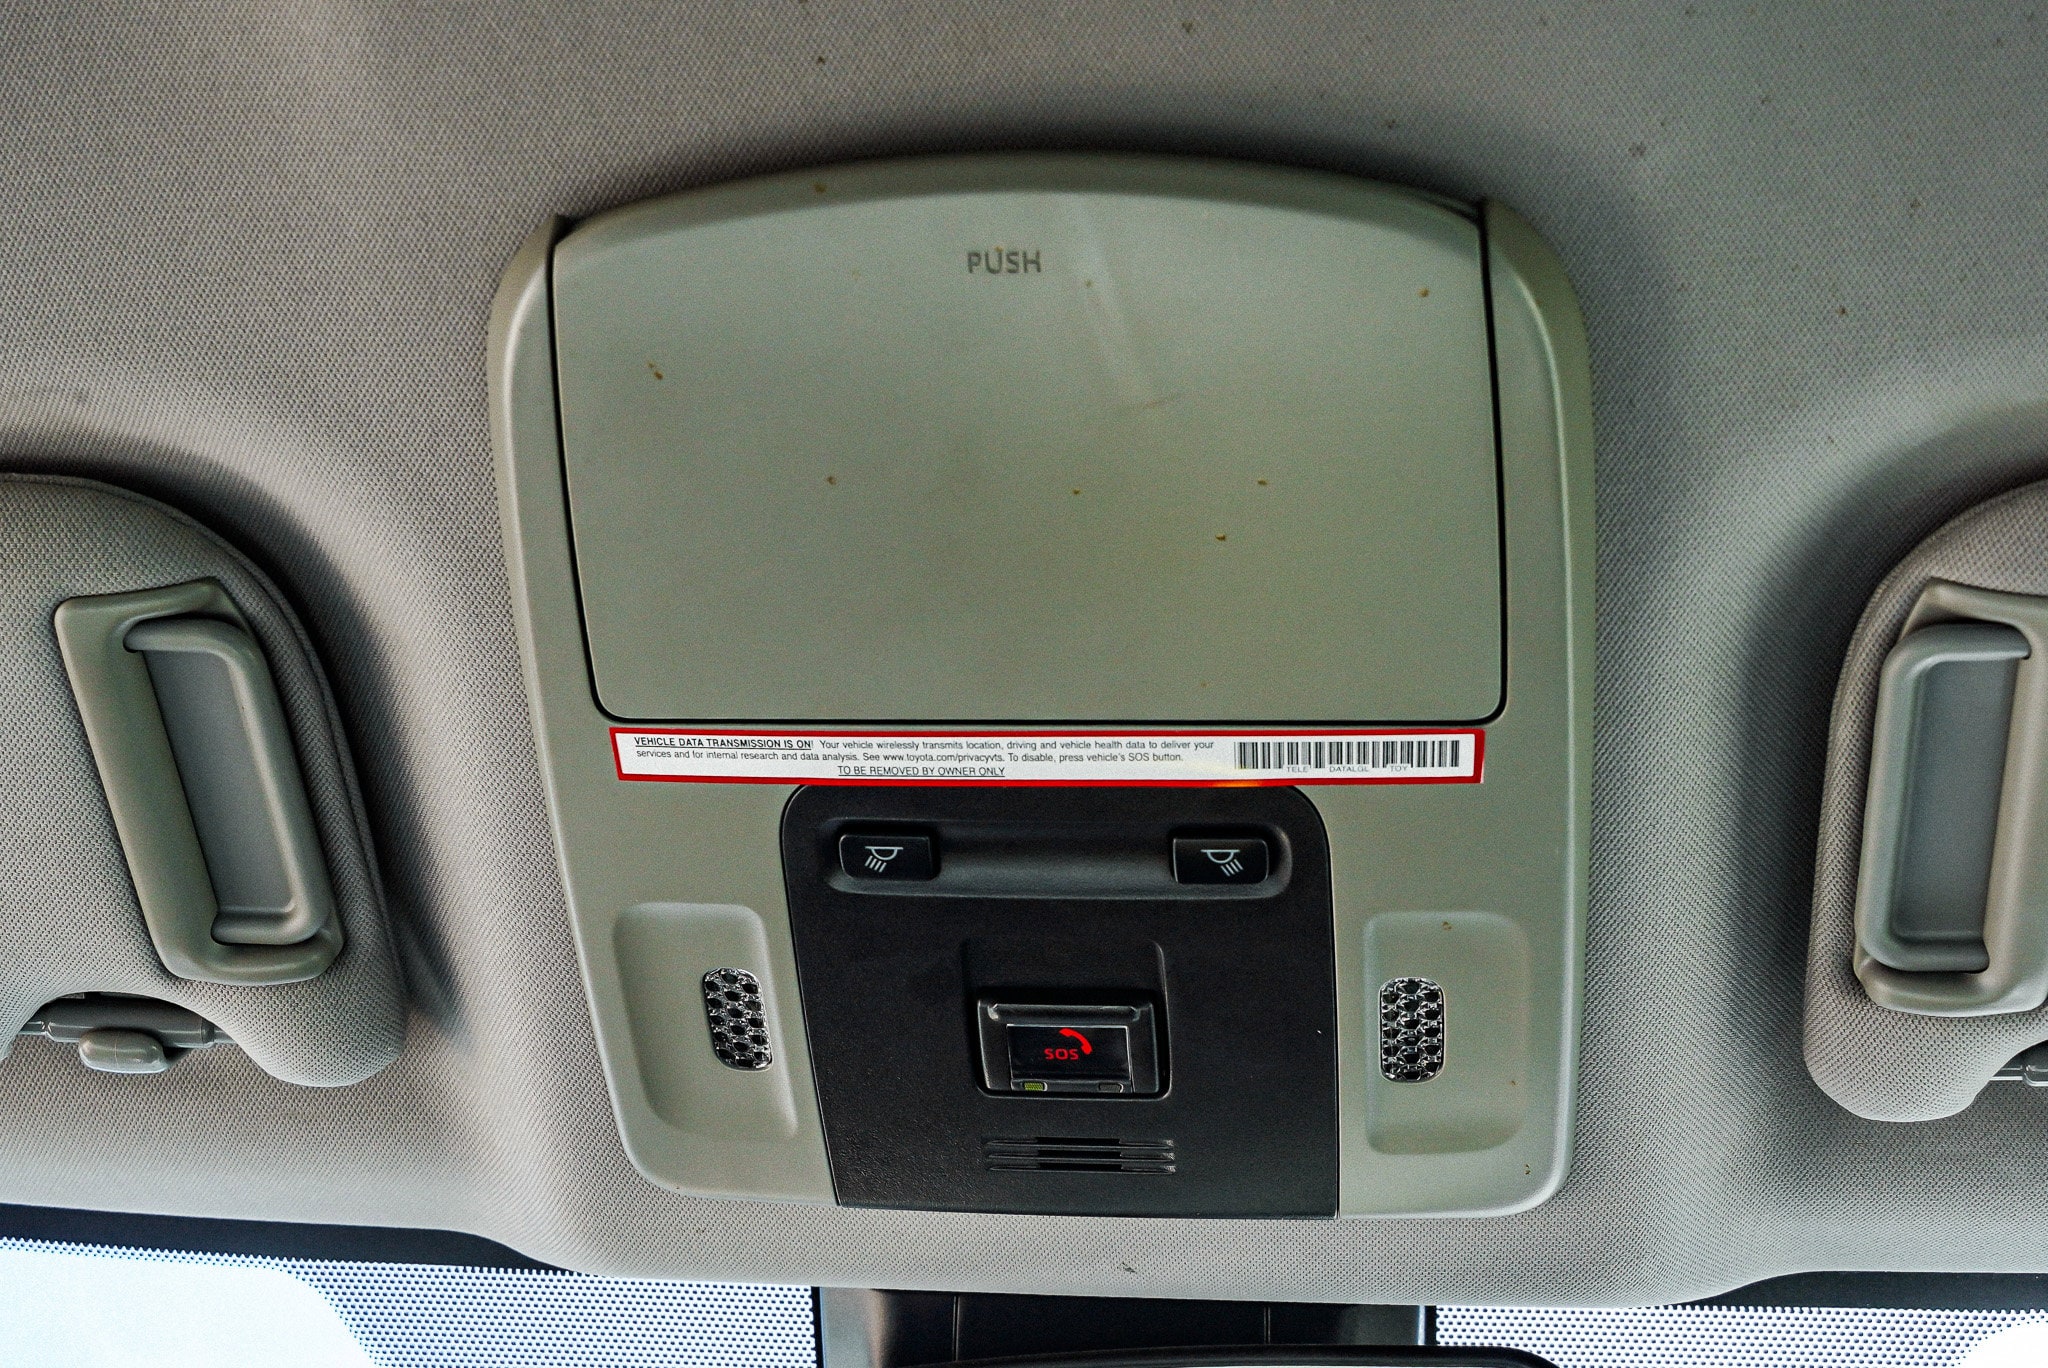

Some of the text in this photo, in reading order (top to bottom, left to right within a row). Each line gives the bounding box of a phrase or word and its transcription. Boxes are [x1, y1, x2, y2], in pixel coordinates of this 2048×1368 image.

[967, 250, 1041, 274] PUSH
[634, 737, 675, 746] VEHICLE
[679, 738, 704, 746] DATA
[706, 738, 781, 748] TRANSMISSION
[784, 740, 793, 748] IS
[820, 741, 839, 749] Your
[842, 741, 873, 749] vehicle
[876, 742, 919, 750] wirelessly
[966, 742, 1004, 750] location,
[1007, 742, 1036, 751] driving
[1194, 742, 1214, 750] your
[636, 750, 671, 758] services
[674, 750, 690, 758] and
[692, 750, 703, 758] for
[706, 751, 738, 759] internal
[740, 752, 778, 760] research
[782, 752, 797, 760] and
[800, 752, 819, 760] data
[822, 753, 859, 762] analysis.
[863, 753, 880, 761] See
[1008, 753, 1018, 762] To
[1022, 754, 1056, 763] disable,
[1059, 754, 1084, 763] press
[1087, 753, 1125, 761] vehicle's
[1128, 753, 1150, 761] SOS
[838, 766, 1005, 776] TO BE REMOVED BY OWNER ONLY
[1390, 764, 1408, 772] TOY
[1043, 1048, 1080, 1061] SOS
